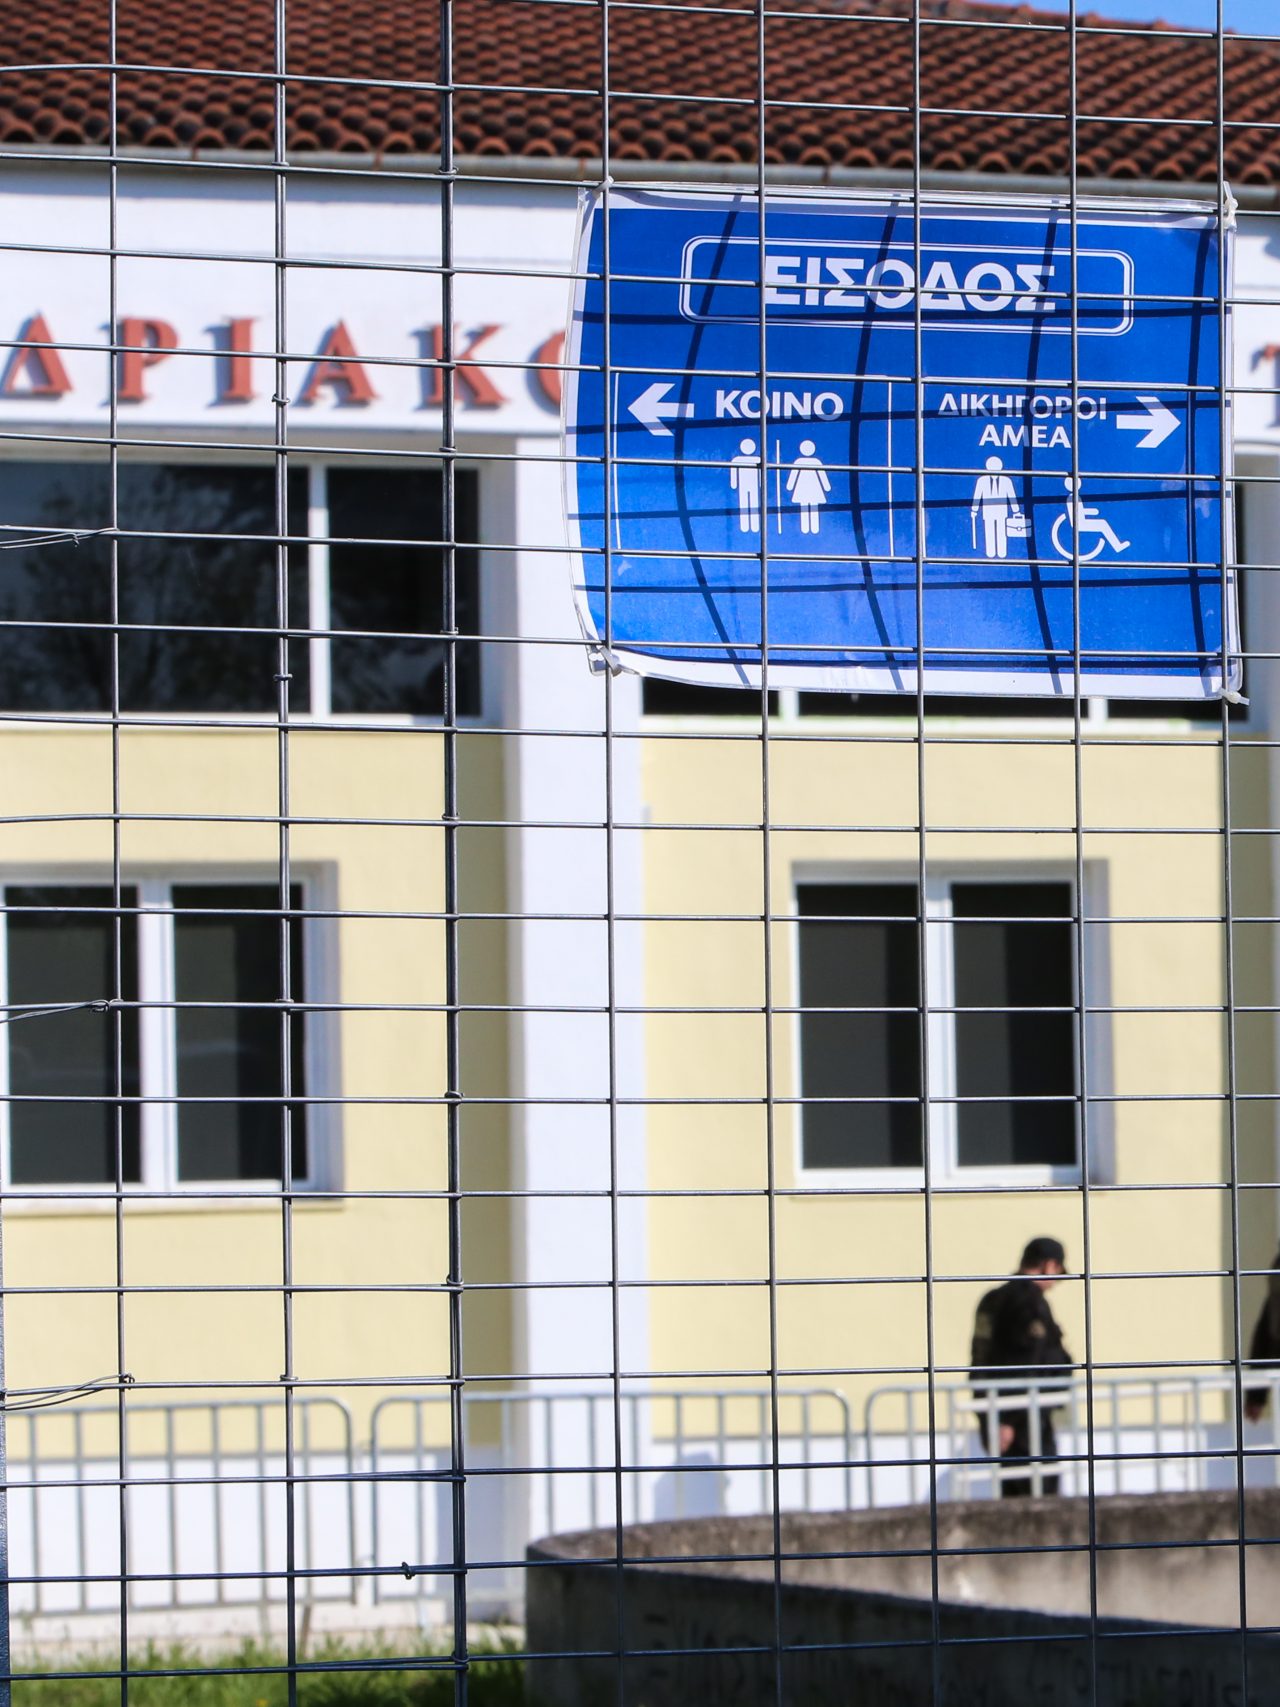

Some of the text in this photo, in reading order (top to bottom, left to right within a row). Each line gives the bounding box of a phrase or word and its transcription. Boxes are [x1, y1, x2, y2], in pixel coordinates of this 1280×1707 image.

[765, 255, 1056, 313] ΕΙΣΟΔΟΣ
[716, 389, 844, 421] ΚΟΙΝΟ
[938, 392, 1107, 420] ΔΙΚΗΓΟΡΟΙ
[978, 424, 1072, 448] ΑΜΕΑ
